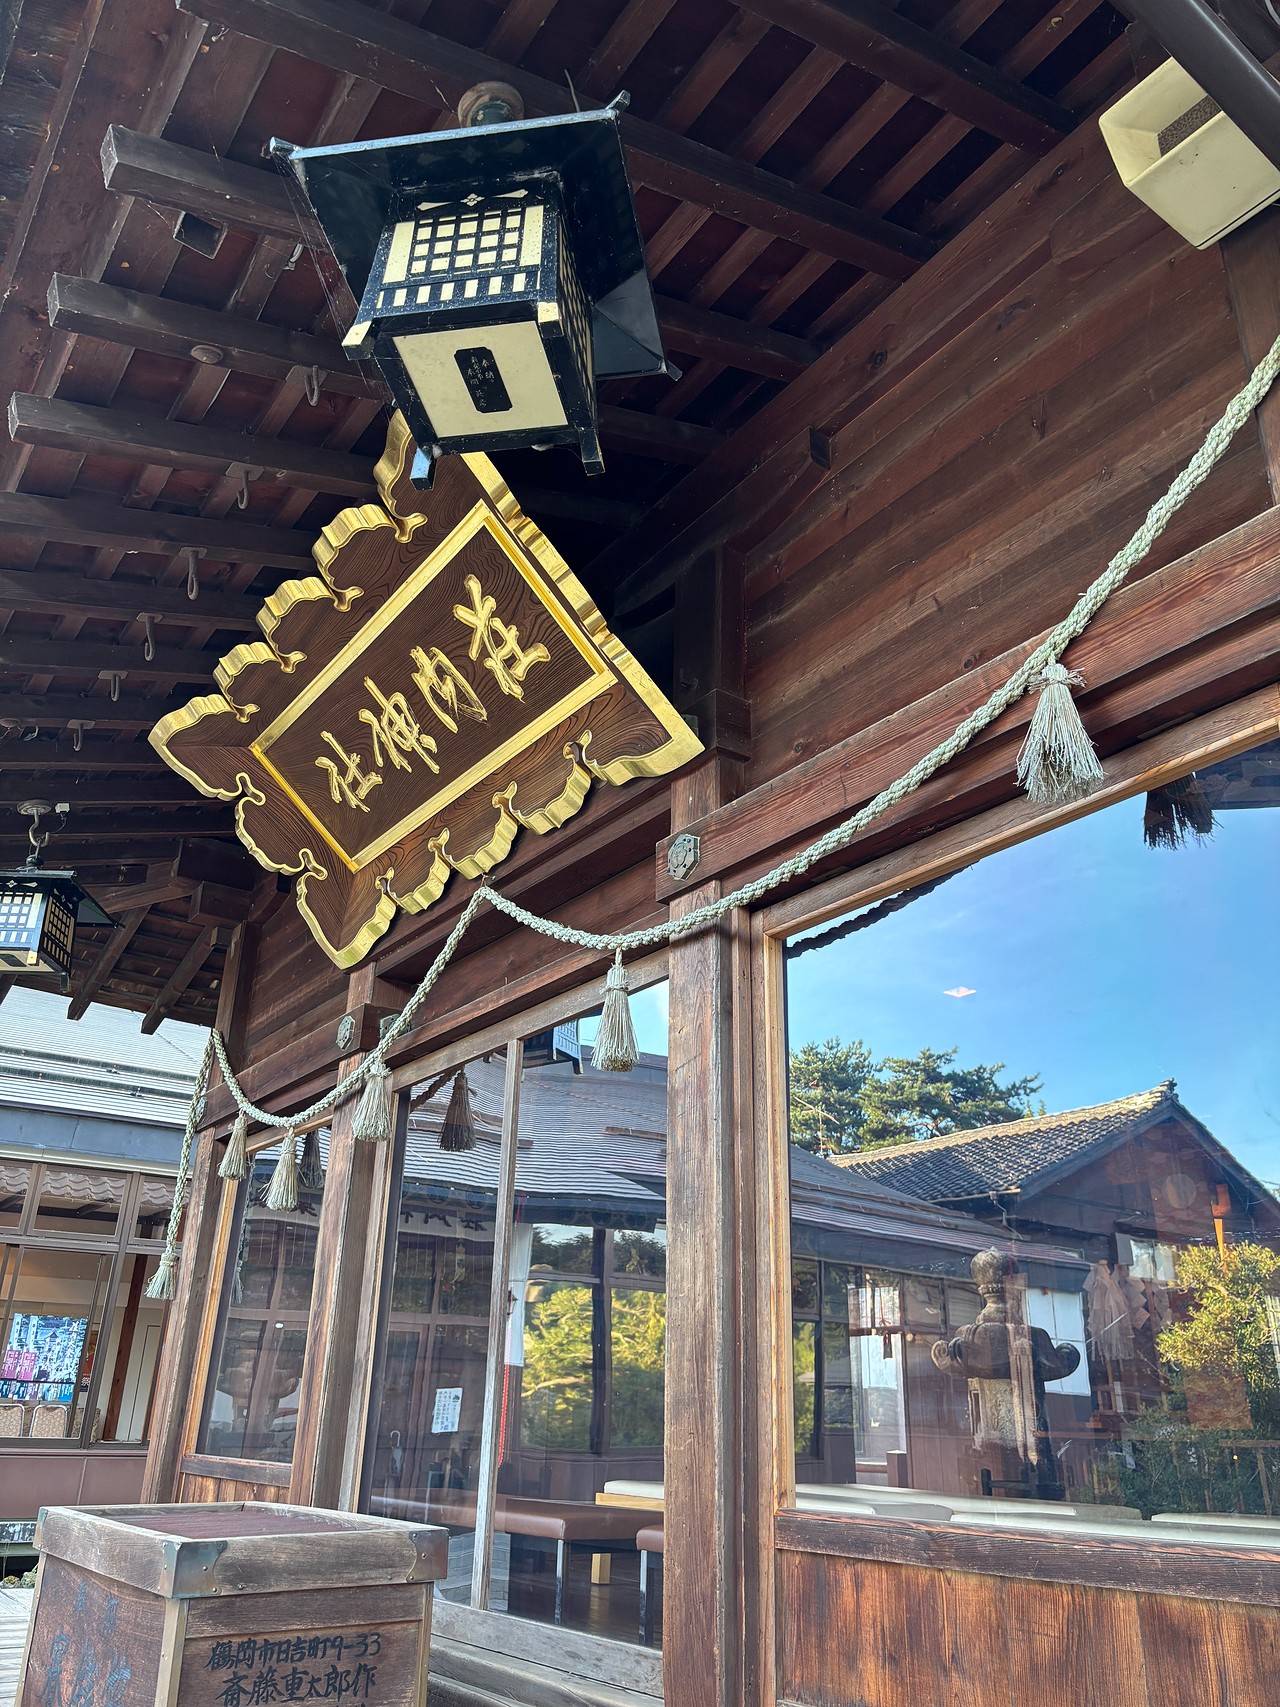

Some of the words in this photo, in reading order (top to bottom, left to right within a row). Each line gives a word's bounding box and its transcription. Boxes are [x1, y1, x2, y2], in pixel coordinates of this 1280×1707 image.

[314, 573, 551, 813] 荘内神社
[204, 1632, 382, 1671] 鶴岡市日吉町9-33
